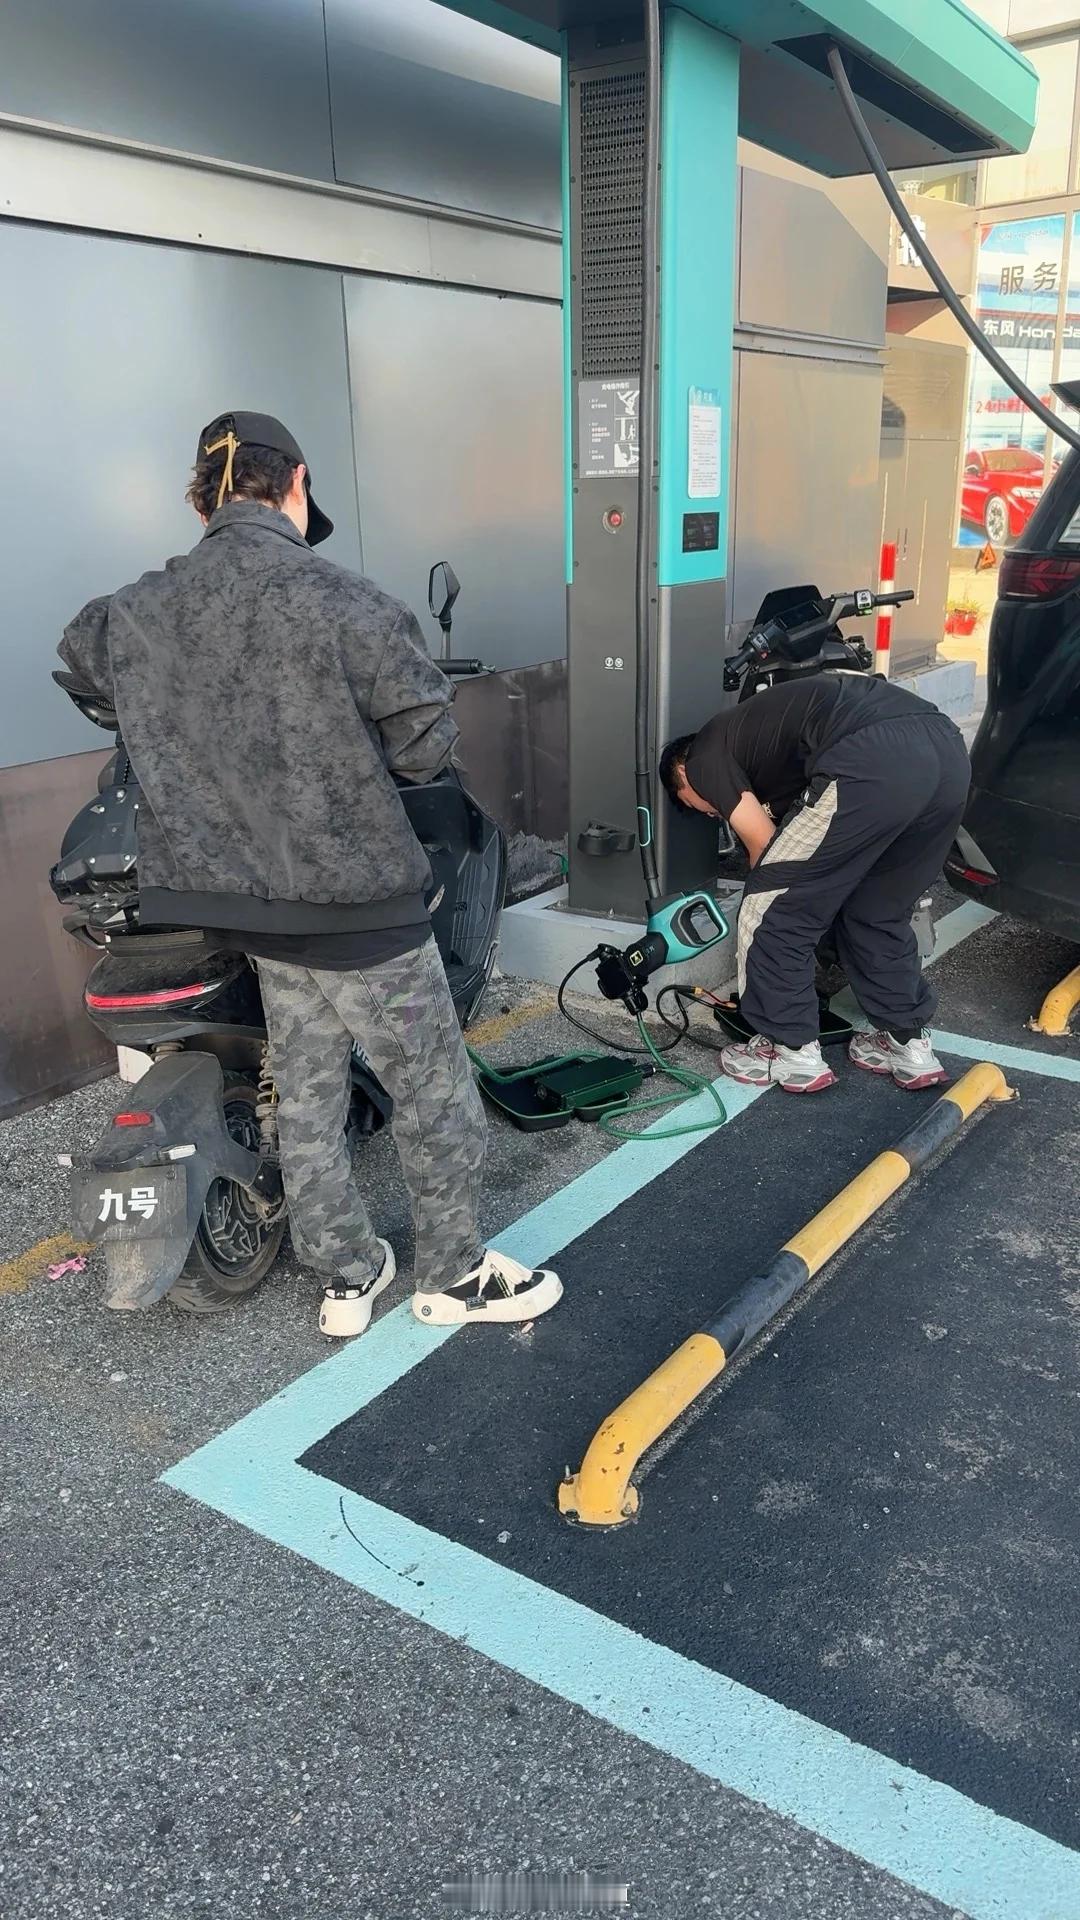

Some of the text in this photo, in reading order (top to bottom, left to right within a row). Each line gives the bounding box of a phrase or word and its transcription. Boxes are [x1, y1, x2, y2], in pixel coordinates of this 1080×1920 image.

[998, 261, 1058, 296] 服务
[983, 319, 1015, 338] 东风
[98, 1186, 159, 1222] 九号
